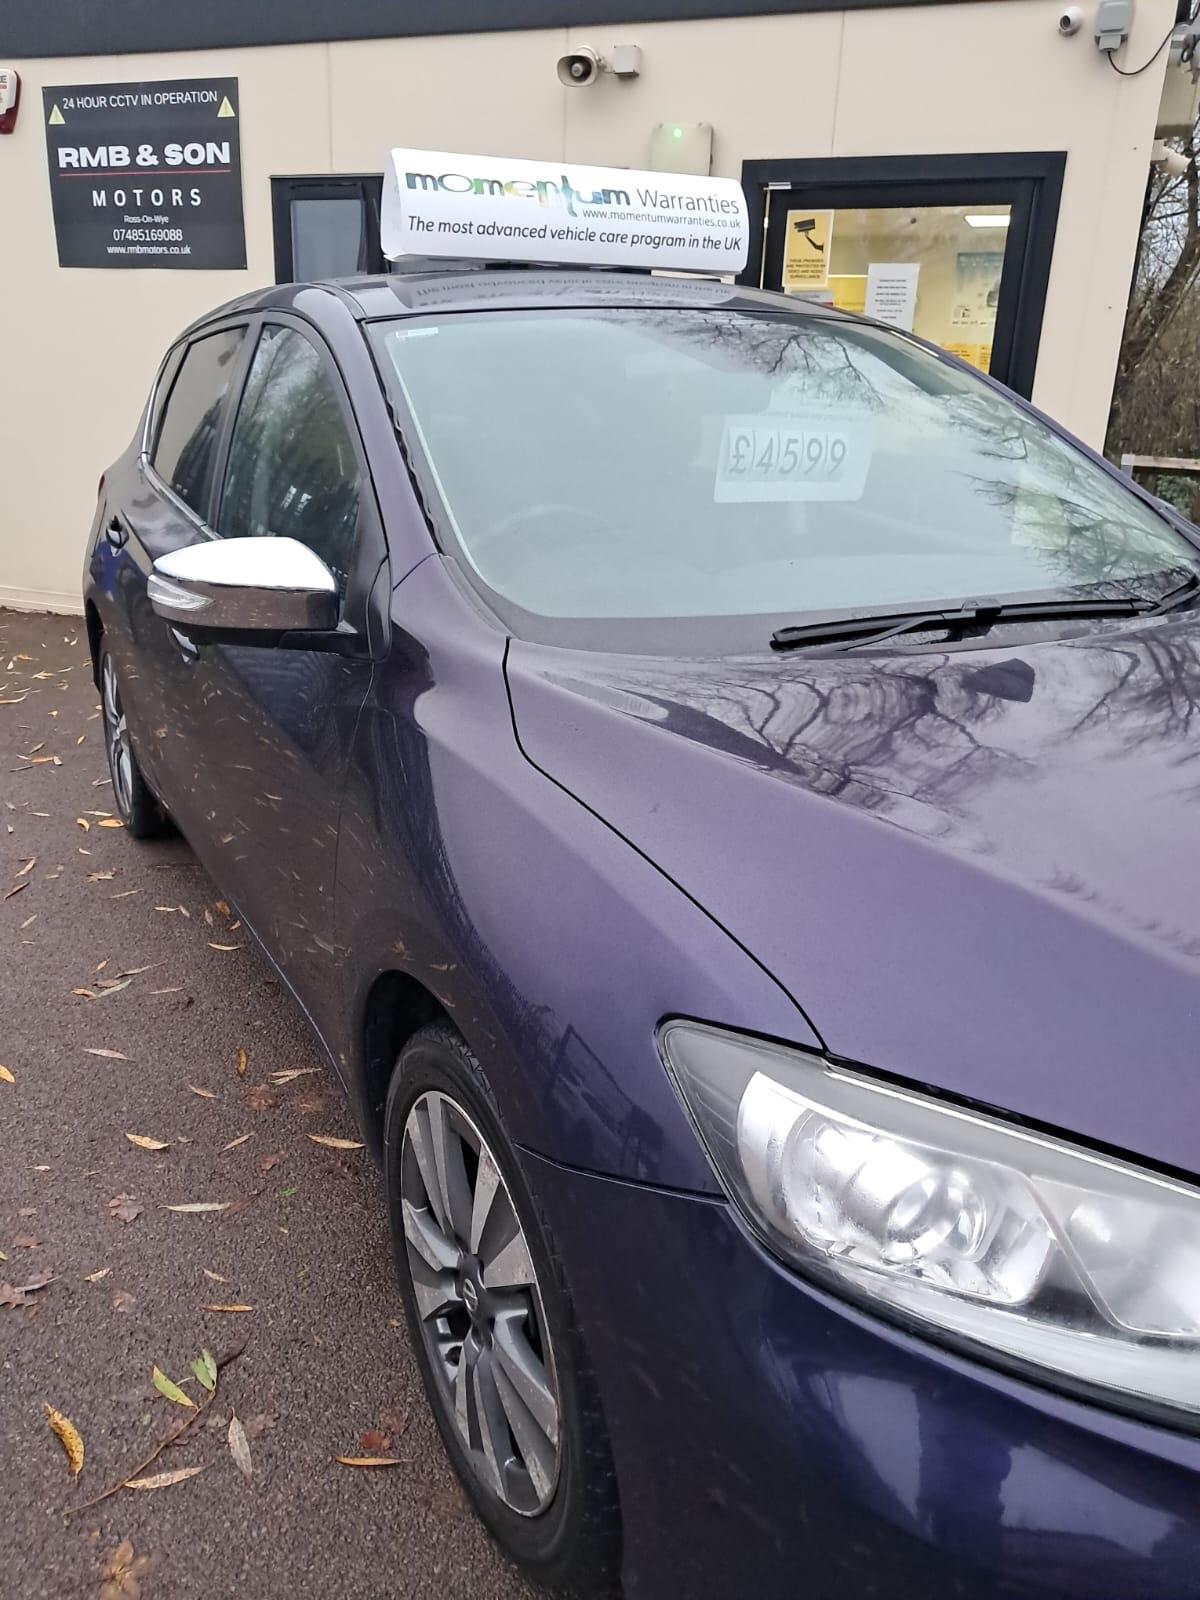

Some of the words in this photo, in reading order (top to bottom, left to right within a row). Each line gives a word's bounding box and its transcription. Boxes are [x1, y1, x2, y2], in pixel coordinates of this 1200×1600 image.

[62, 98, 75, 110] 24
[76, 96, 107, 109] HOUR
[109, 94, 139, 108] CCTV
[140, 94, 152, 106] IN
[153, 90, 218, 105] OPERATION
[57, 145, 131, 168] RMB
[135, 144, 159, 167] &
[164, 141, 231, 166] SON
[92, 188, 202, 207] MOTORS
[405, 172, 631, 216] momentum
[636, 188, 740, 215] Warranties
[123, 215, 169, 224] Ross-On-Wye
[582, 208, 741, 229] www.momentumwarranties.co.uk
[113, 228, 183, 242] 07485169088
[408, 215, 435, 232] The
[438, 220, 473, 235] most
[476, 221, 547, 239] advanced
[549, 227, 597, 242] vehicle
[599, 231, 629, 244] care
[630, 233, 686, 250] program
[688, 234, 700, 249] in
[702, 236, 722, 250] the
[724, 239, 742, 251] UK
[106, 244, 192, 255] www.rmbmotors.co.uk
[728, 434, 847, 475] £4599
